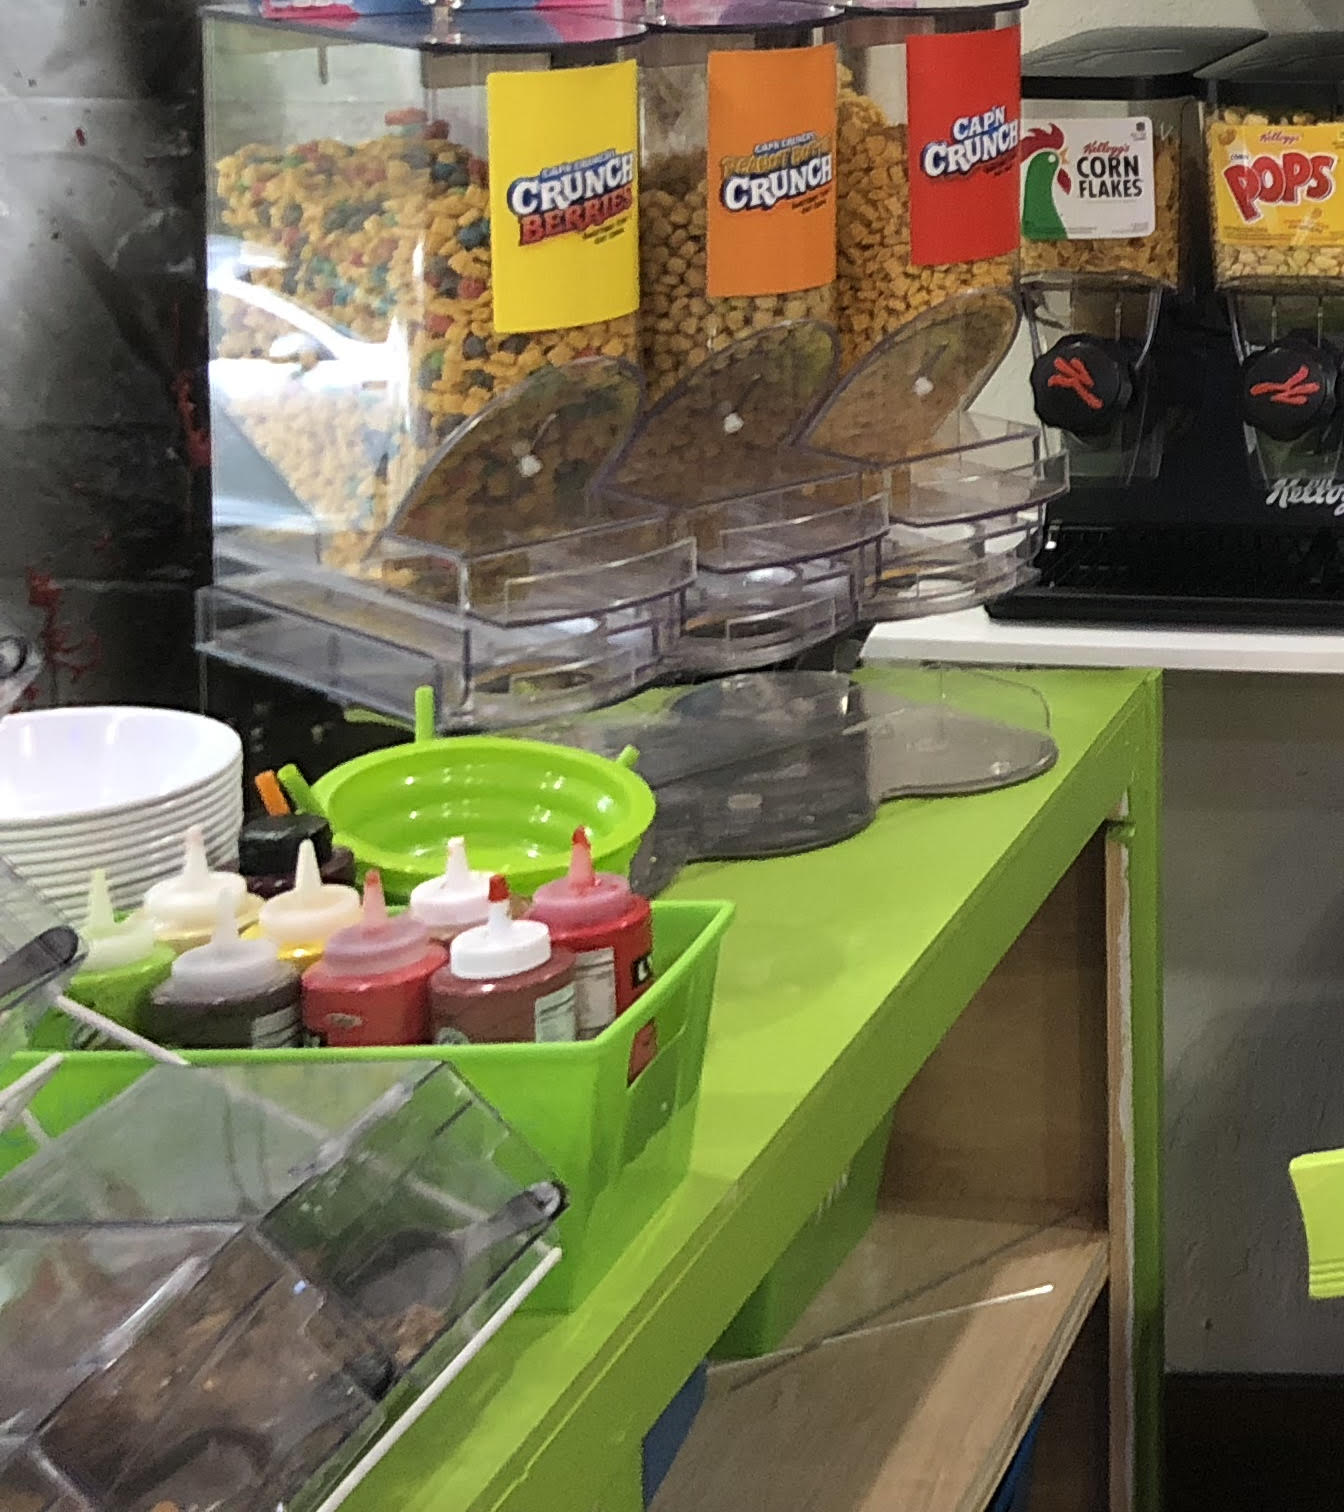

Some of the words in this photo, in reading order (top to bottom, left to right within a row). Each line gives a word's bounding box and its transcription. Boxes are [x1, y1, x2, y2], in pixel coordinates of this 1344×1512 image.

[921, 119, 1019, 177] CRUNCH
[1077, 156, 1140, 178] CORN
[1083, 141, 1129, 154] Kellogg's
[512, 153, 633, 215] CRUNCH
[725, 154, 832, 210] CRUNCH
[1078, 179, 1142, 198] FLAKES
[1223, 152, 1336, 222] POPS
[519, 184, 632, 246] BERRIES
